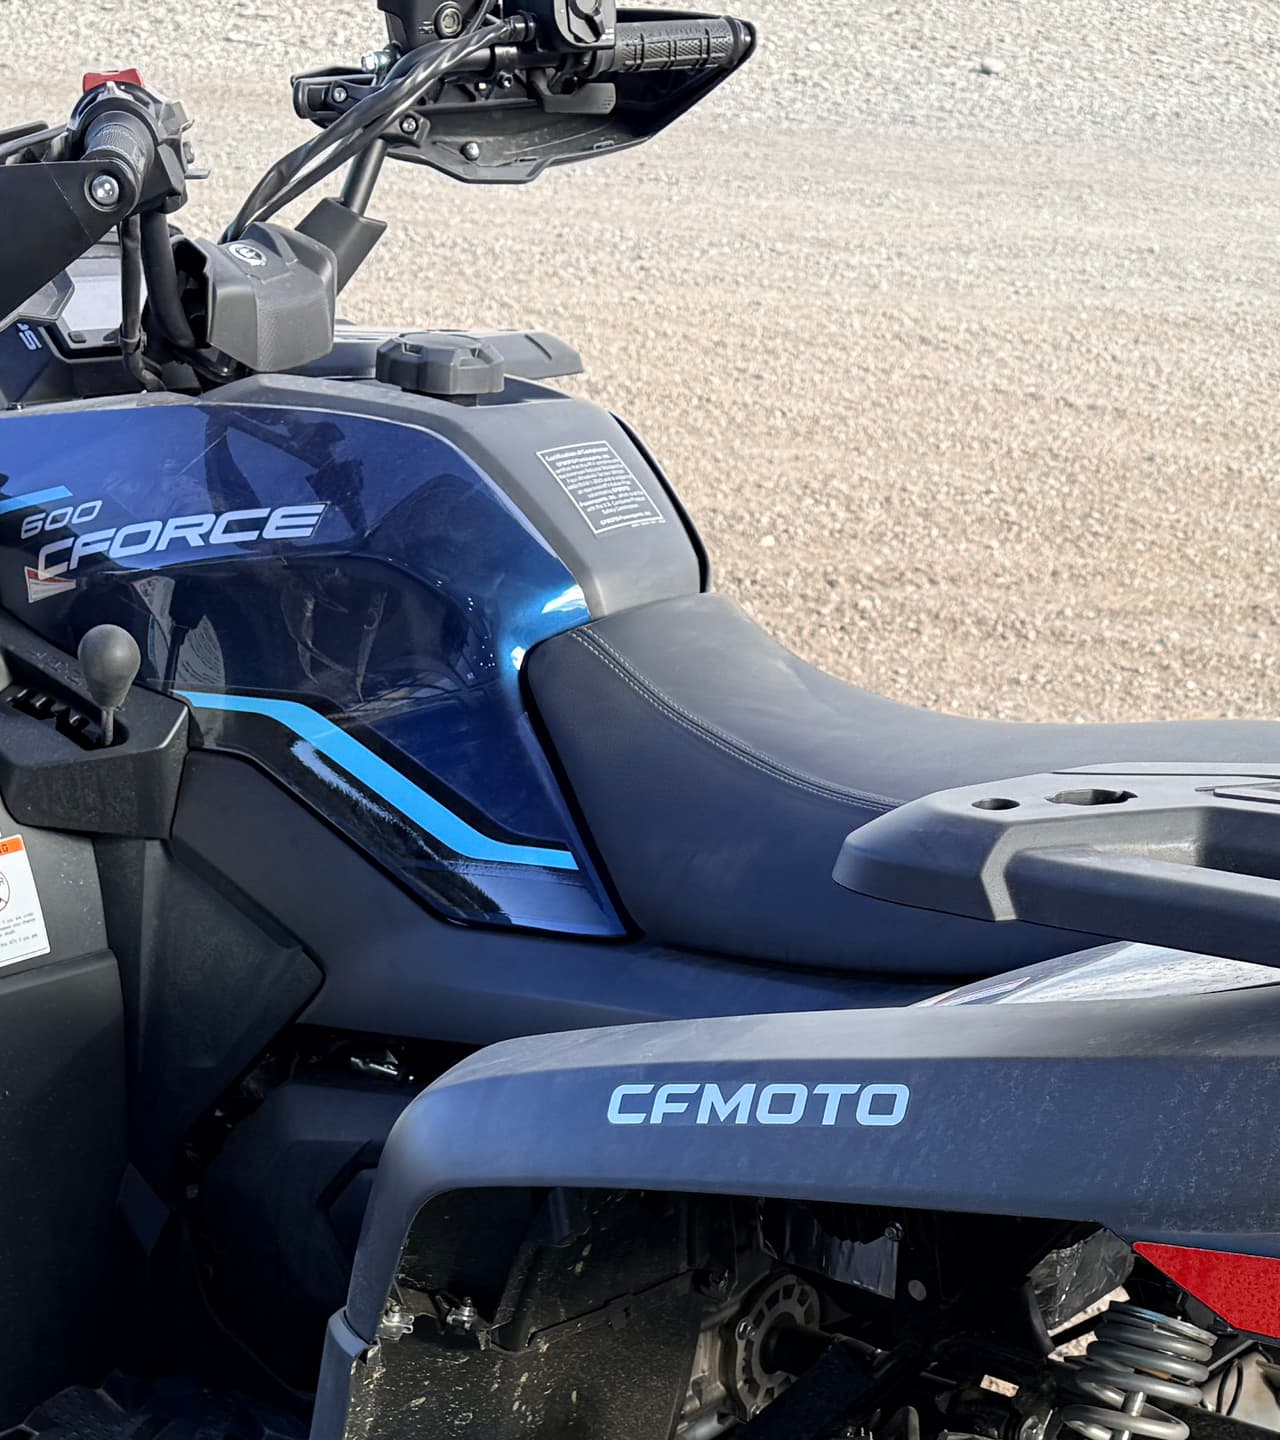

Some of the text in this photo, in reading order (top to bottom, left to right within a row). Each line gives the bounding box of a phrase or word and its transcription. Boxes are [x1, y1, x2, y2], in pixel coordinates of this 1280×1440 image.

[21, 500, 102, 539] 600
[38, 503, 328, 580] CFORCE
[607, 1083, 910, 1126] CFMOTO
